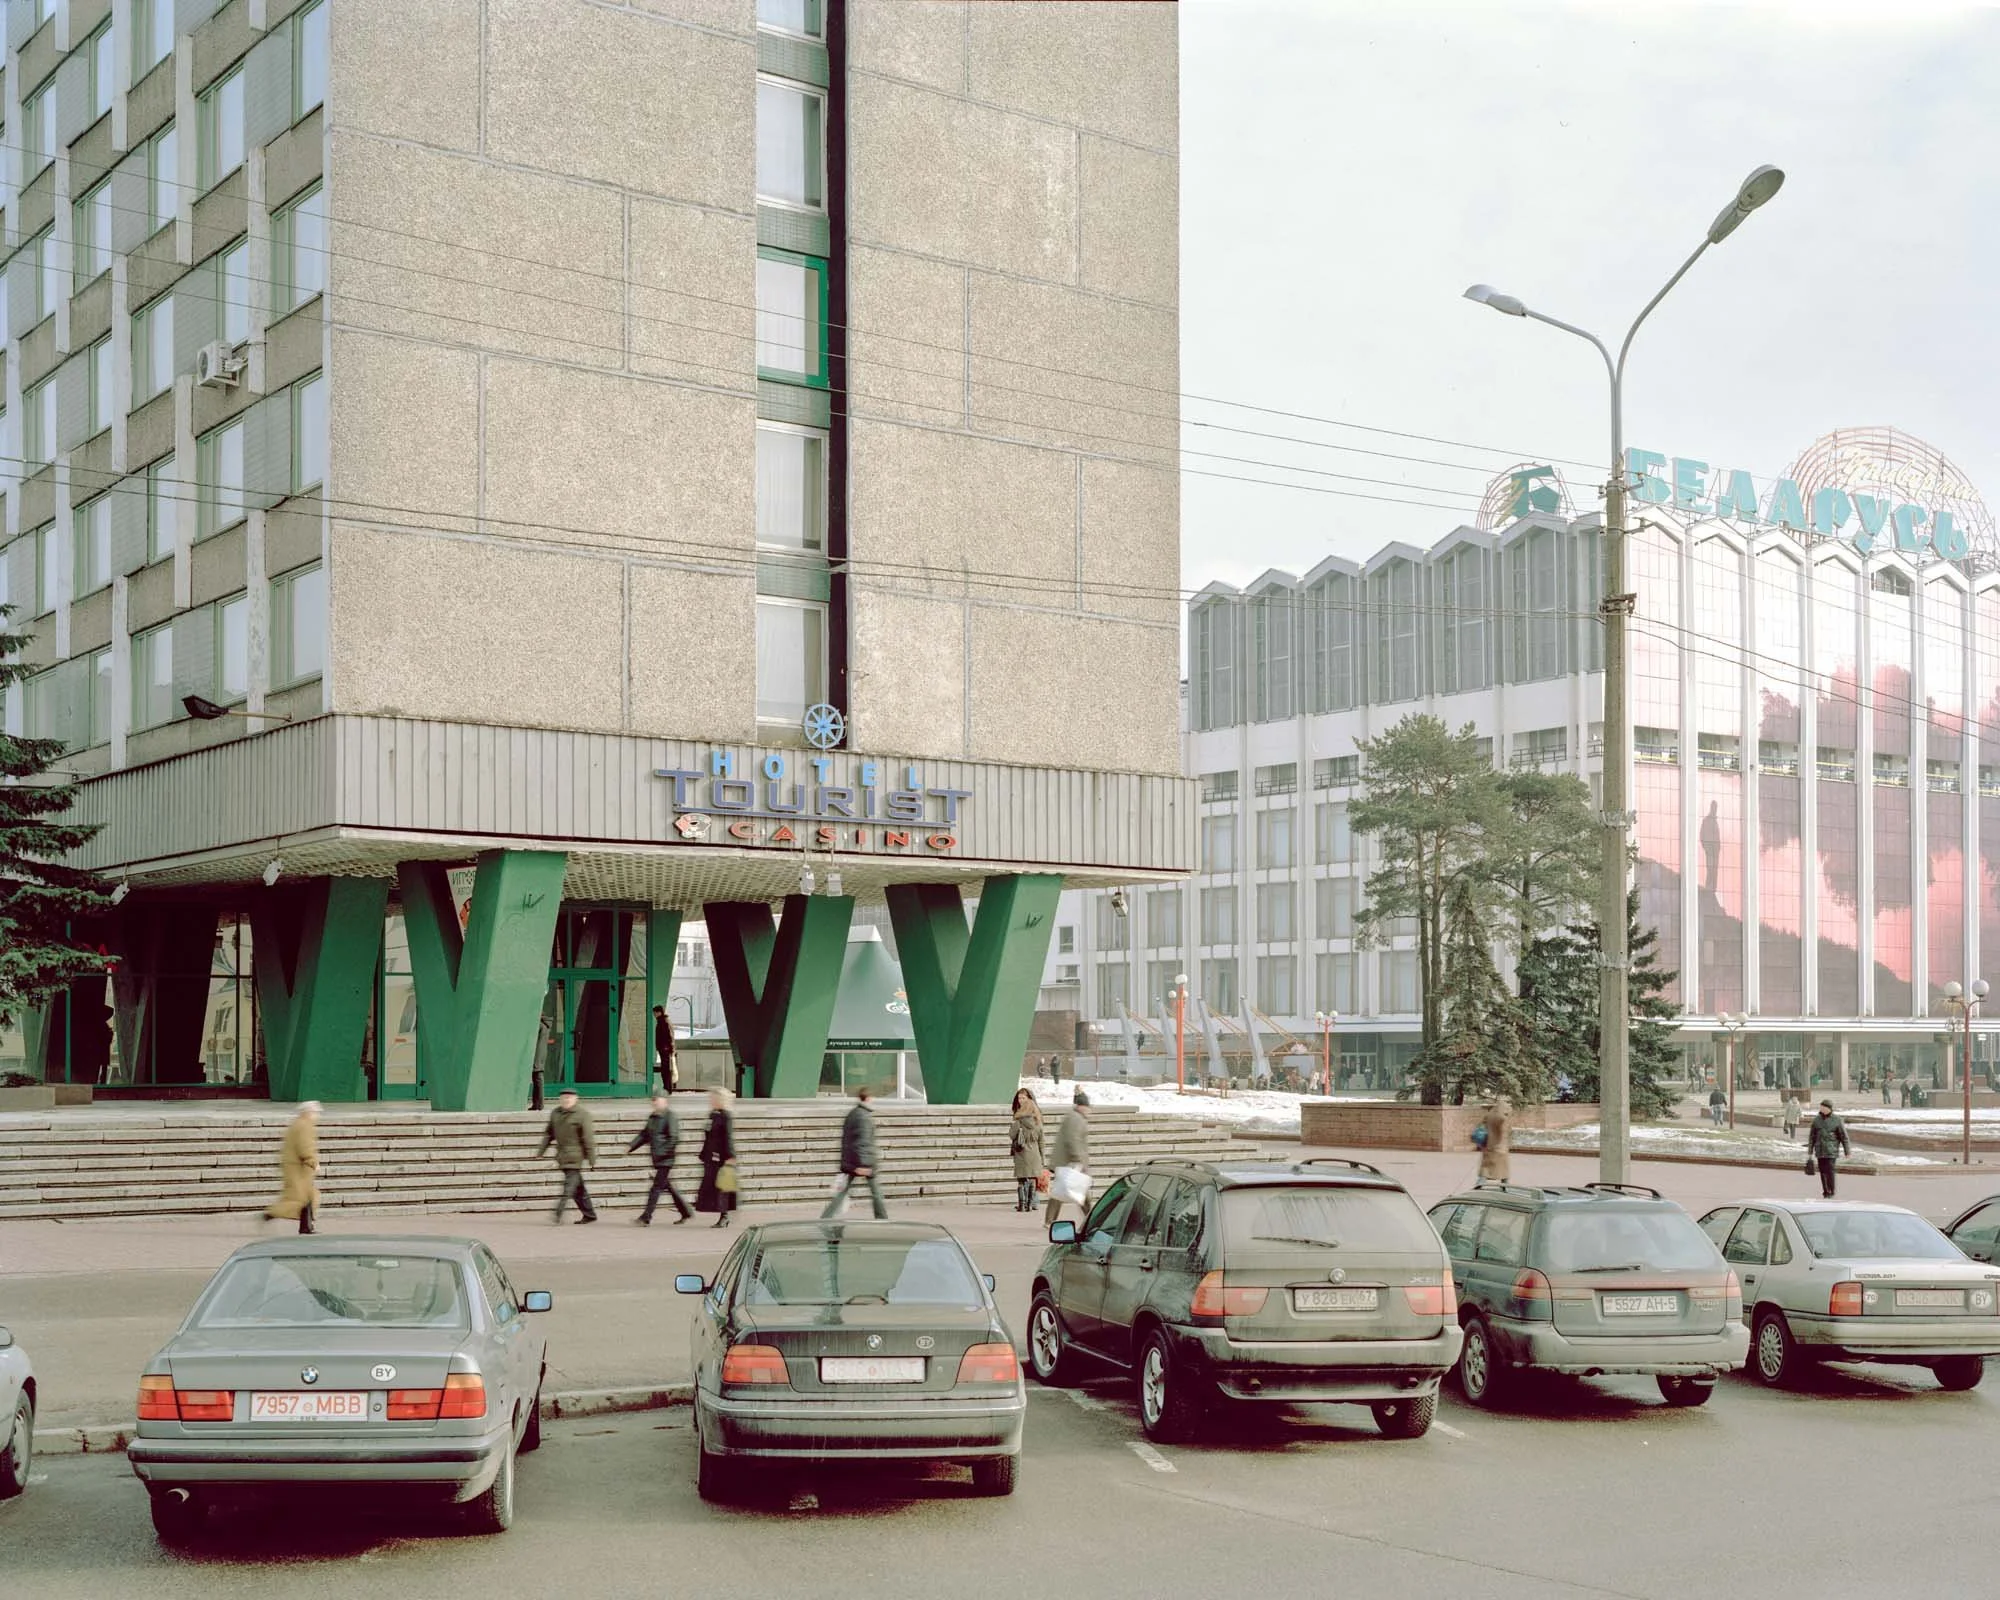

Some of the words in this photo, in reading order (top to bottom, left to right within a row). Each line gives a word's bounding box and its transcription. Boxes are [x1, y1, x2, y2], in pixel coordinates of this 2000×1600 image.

[1624, 447, 1969, 560] БЕЛАРУСЬ
[712, 751, 922, 790] HOTEL
[654, 768, 973, 822] TOURIST
[729, 821, 957, 849] CASINO
[1615, 1297, 1641, 1311] 5527
[1975, 1293, 1988, 1305] BY
[375, 1368, 393, 1378] BY
[256, 1395, 299, 1415] 7957
[316, 1395, 361, 1414] MBB
